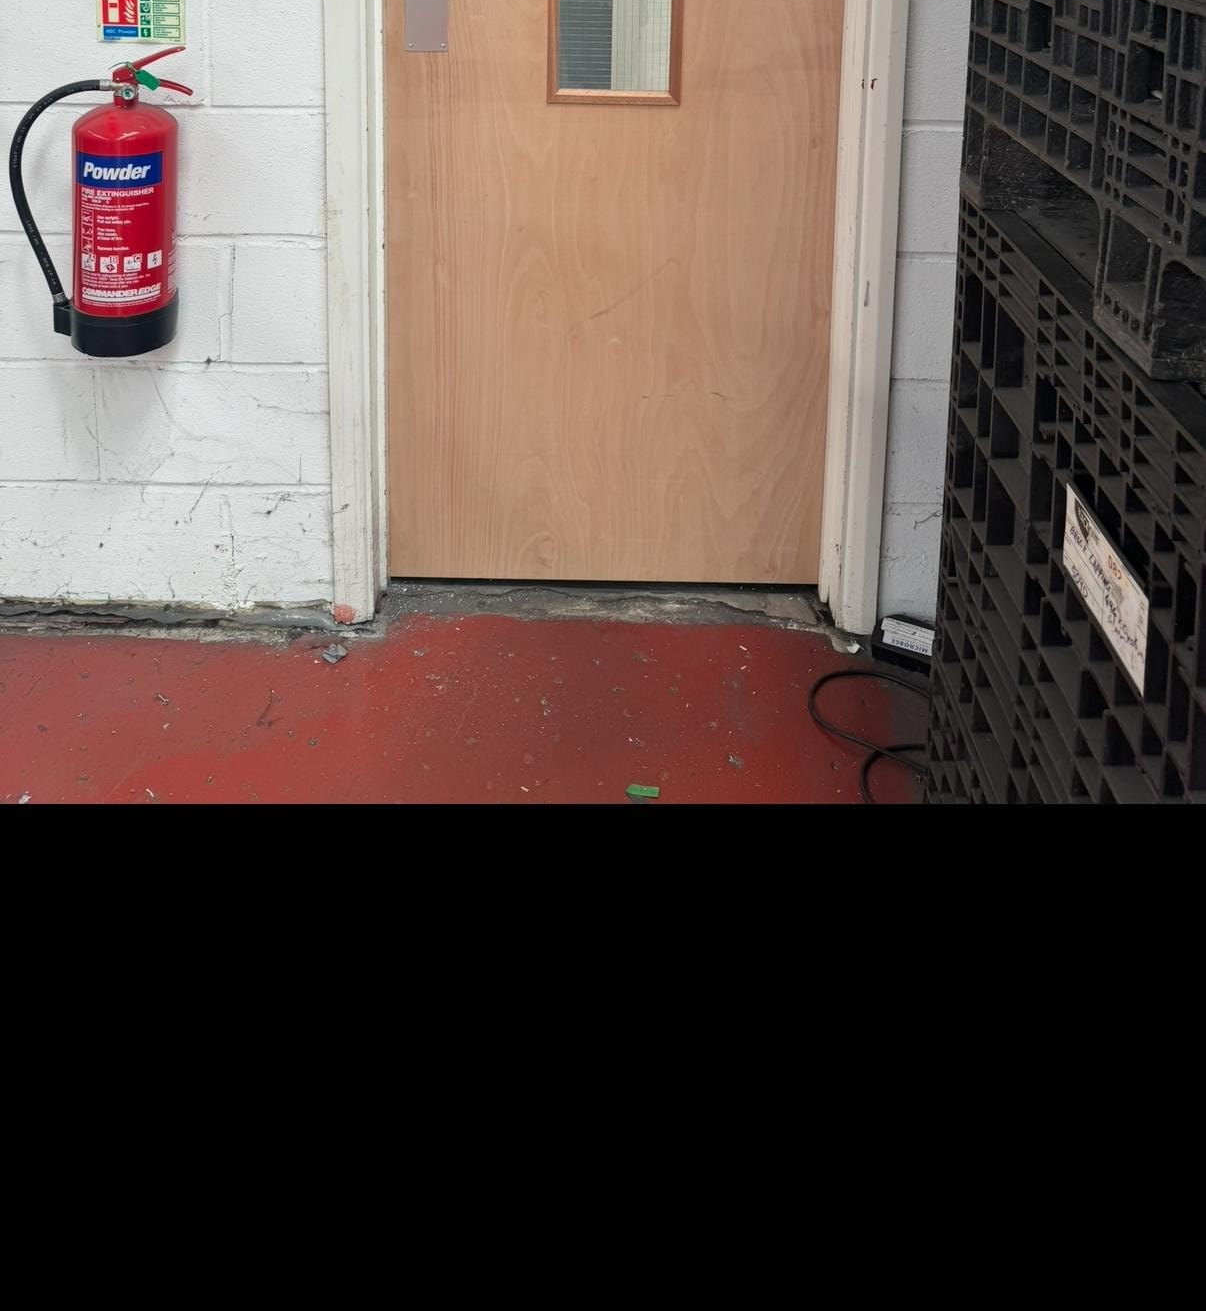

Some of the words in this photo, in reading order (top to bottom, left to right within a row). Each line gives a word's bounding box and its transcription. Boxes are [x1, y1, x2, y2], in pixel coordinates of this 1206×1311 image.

[83, 161, 151, 180] Powder
[81, 187, 95, 196] FIRE
[96, 187, 154, 198] EXTINGUISHER
[82, 287, 138, 297] COMMANDER
[138, 282, 162, 295] EDGE
